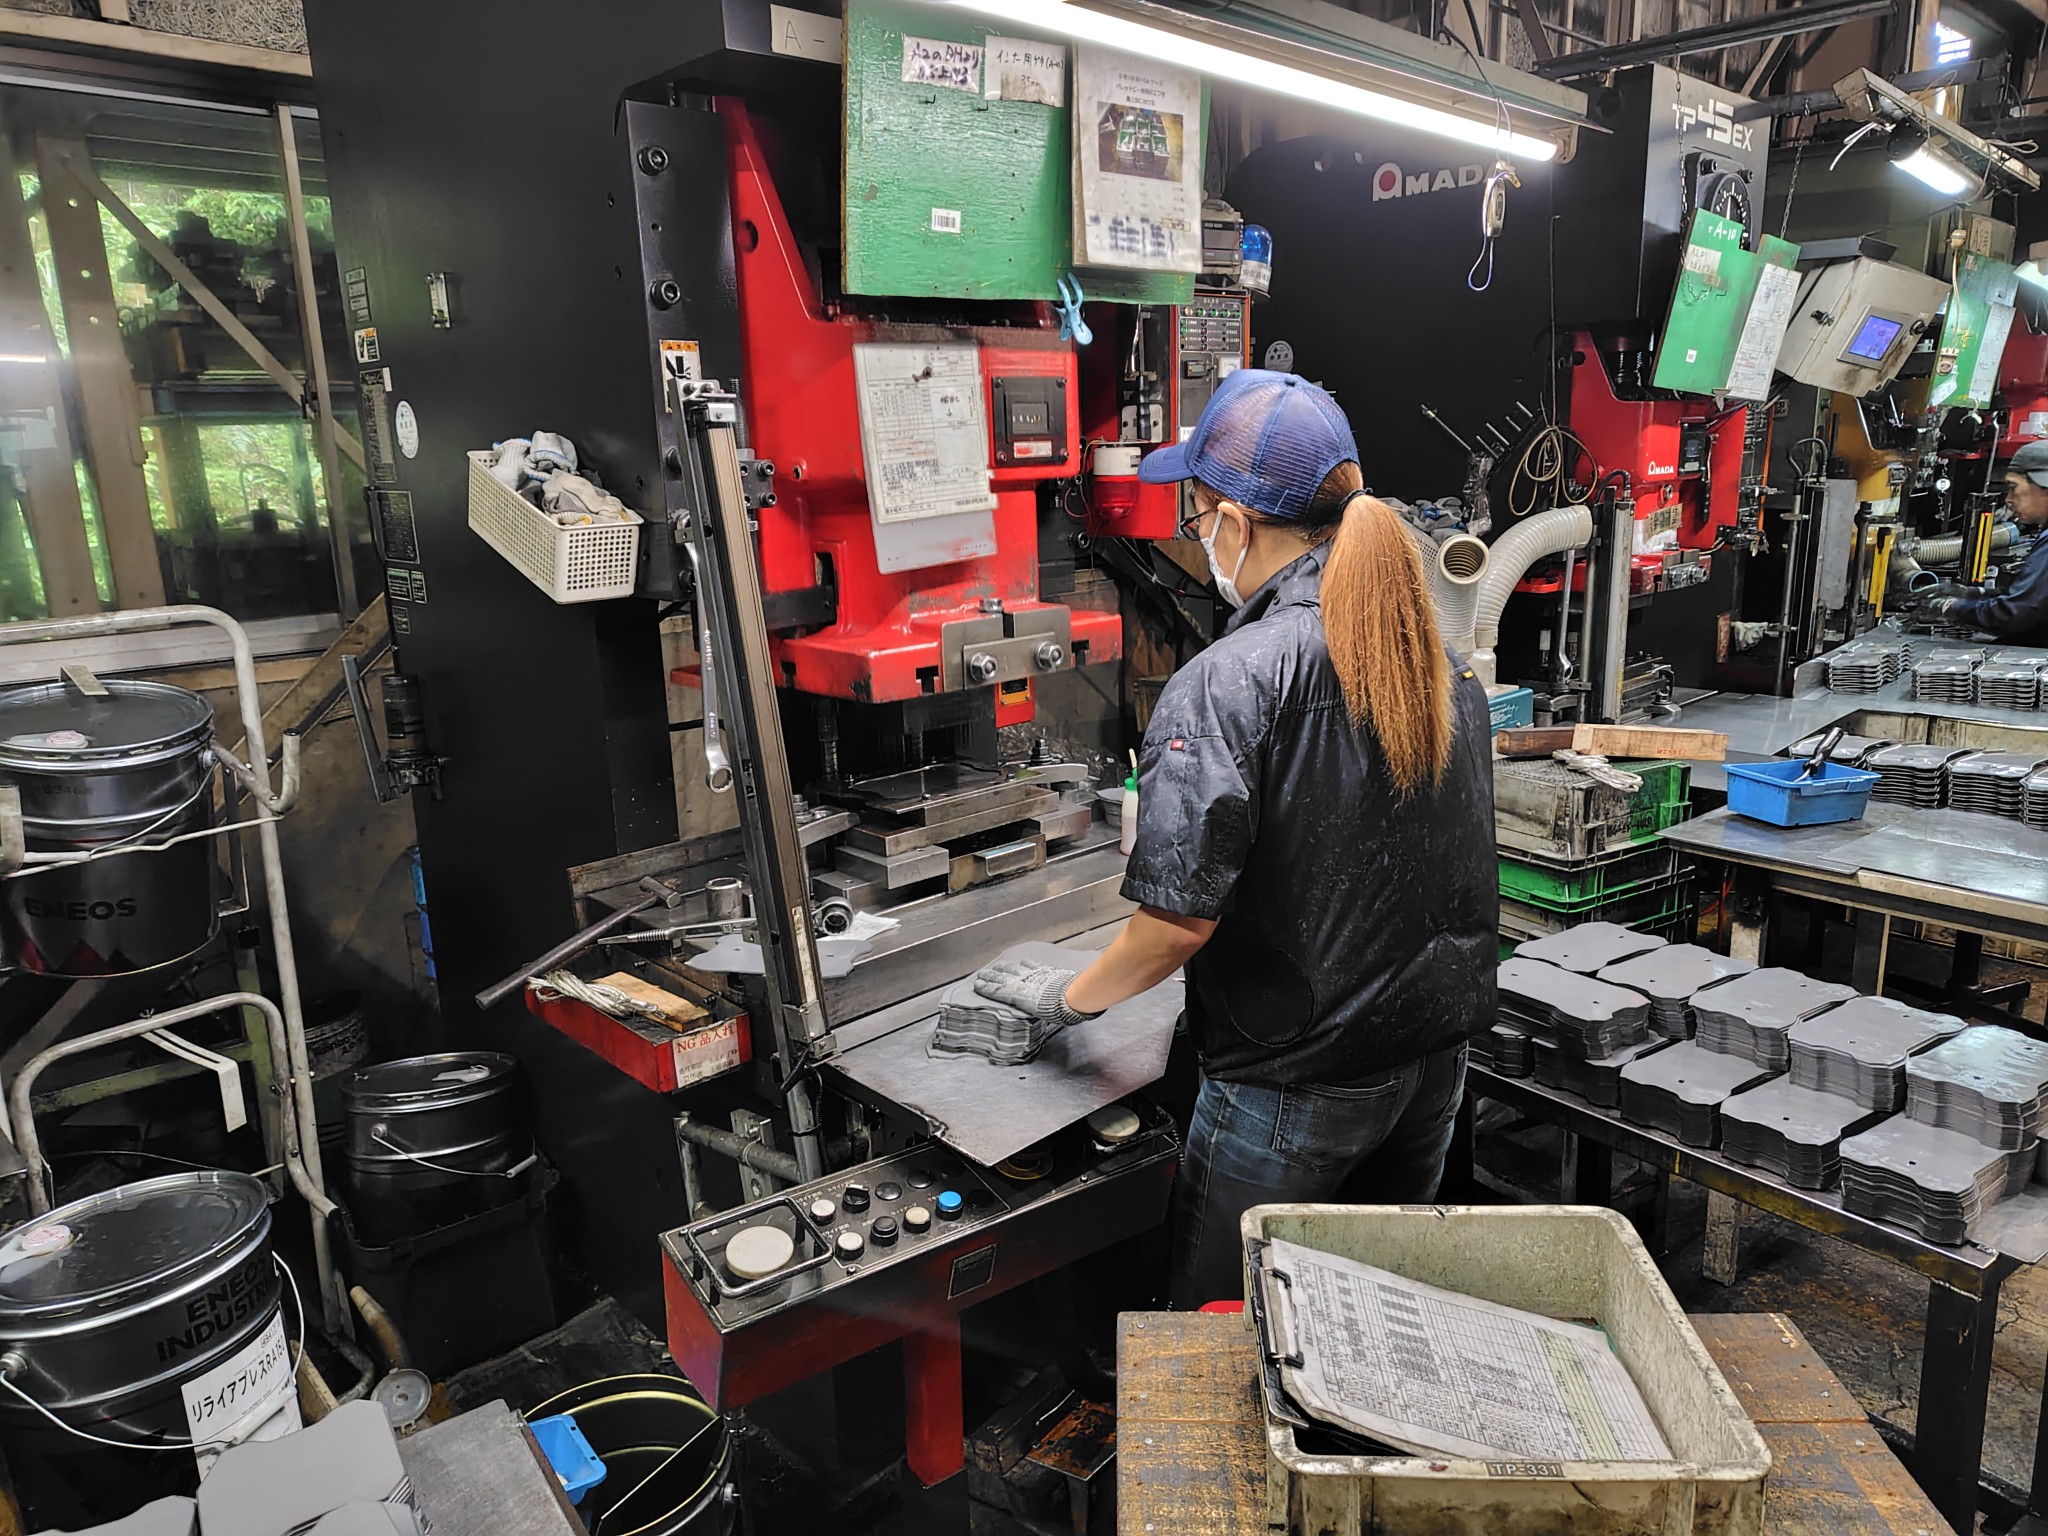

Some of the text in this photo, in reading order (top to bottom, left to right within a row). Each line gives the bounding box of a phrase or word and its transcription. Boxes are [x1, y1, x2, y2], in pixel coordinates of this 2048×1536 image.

[1648, 461, 1674, 476] AMADA
[24, 896, 137, 921] ENEOS
[677, 1024, 736, 1053] NG 品入れ
[185, 1250, 268, 1324] ENEOS
[1493, 1463, 1558, 1475] TP-331
